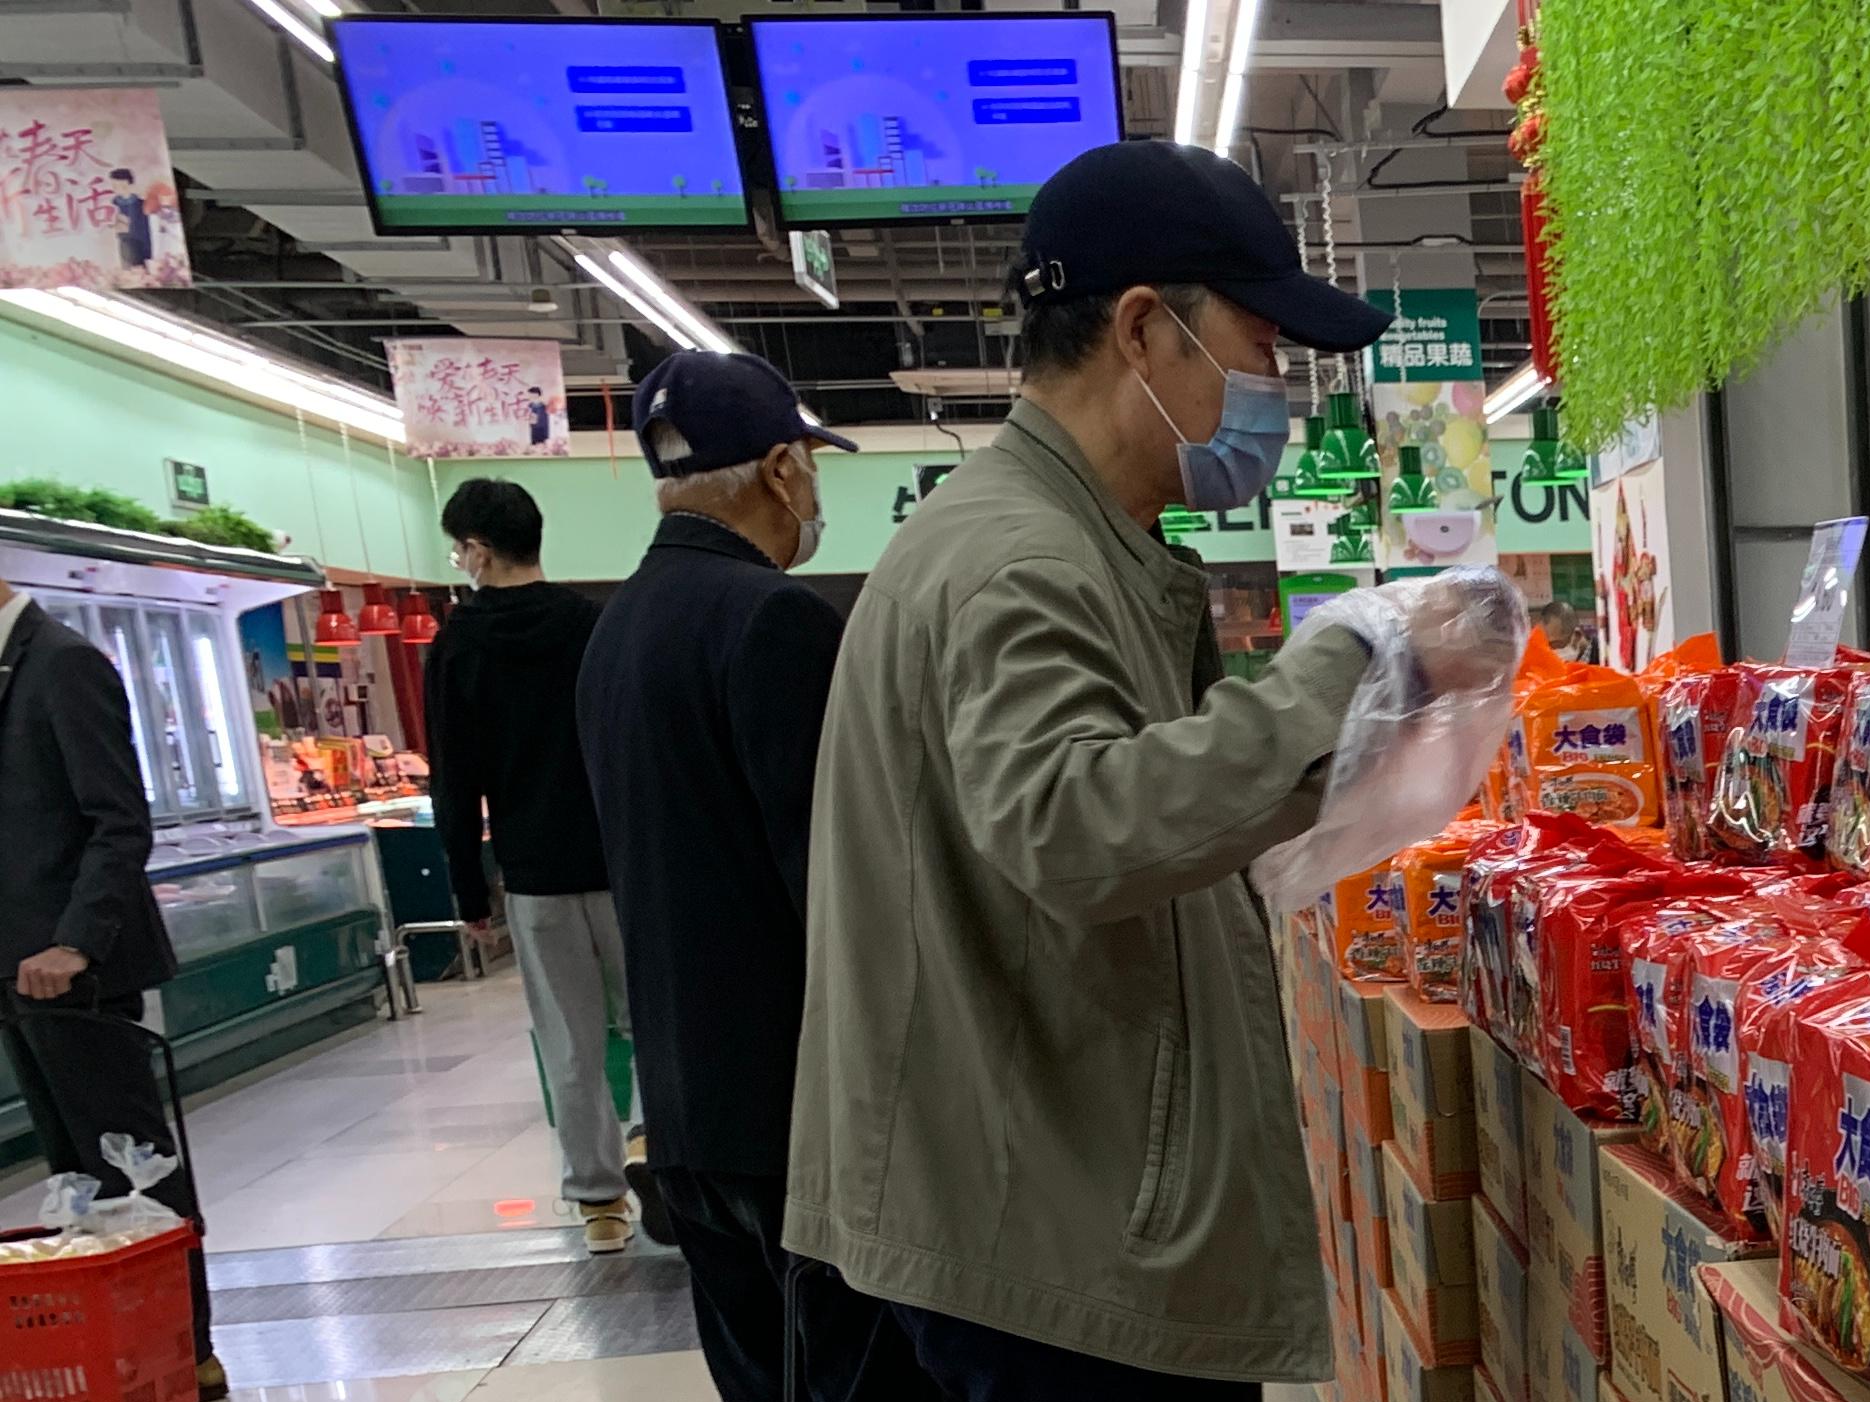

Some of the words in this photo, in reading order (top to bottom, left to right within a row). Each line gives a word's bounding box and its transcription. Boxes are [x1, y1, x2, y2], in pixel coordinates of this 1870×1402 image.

[1380, 343, 1473, 367] 精品果蔬
[1554, 724, 1627, 752] 大食袋
